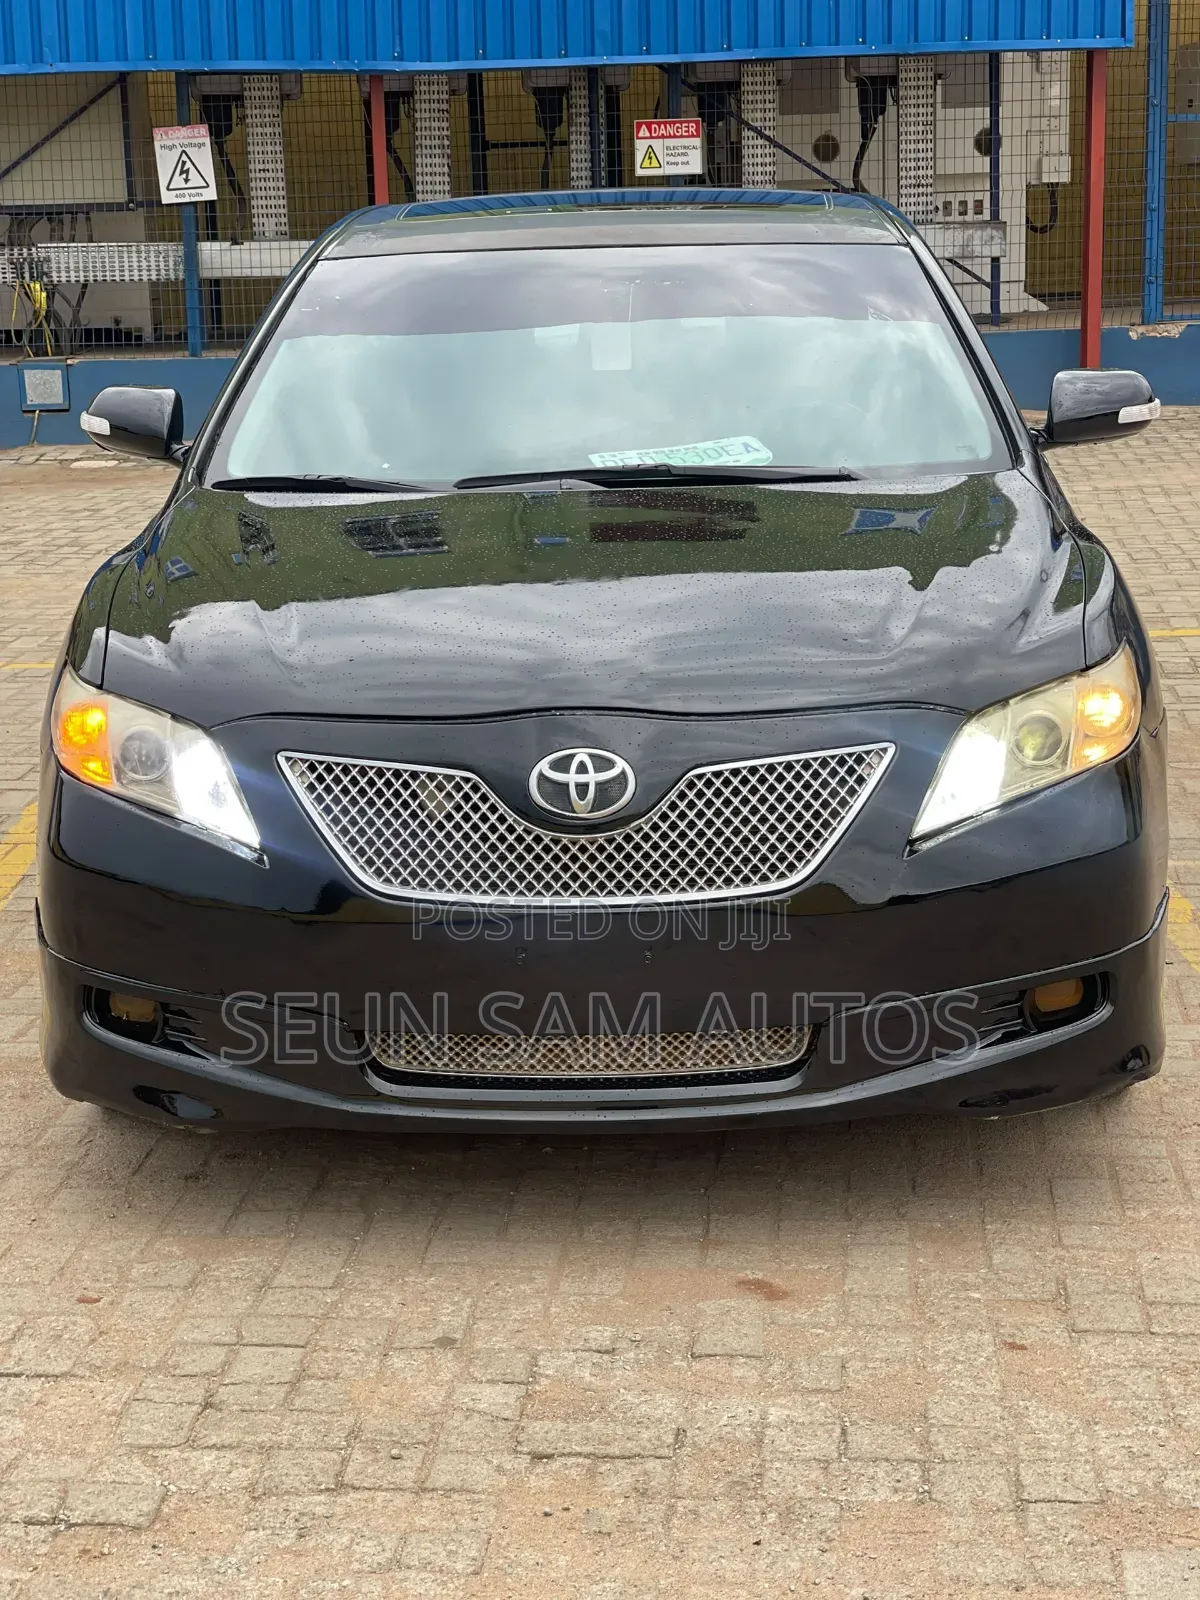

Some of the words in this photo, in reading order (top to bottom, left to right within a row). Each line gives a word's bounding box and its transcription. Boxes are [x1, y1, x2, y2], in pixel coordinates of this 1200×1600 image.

[168, 128, 207, 139] DANGER
[652, 123, 697, 137] DANGER
[160, 143, 178, 151] High
[179, 141, 206, 150] Voltage
